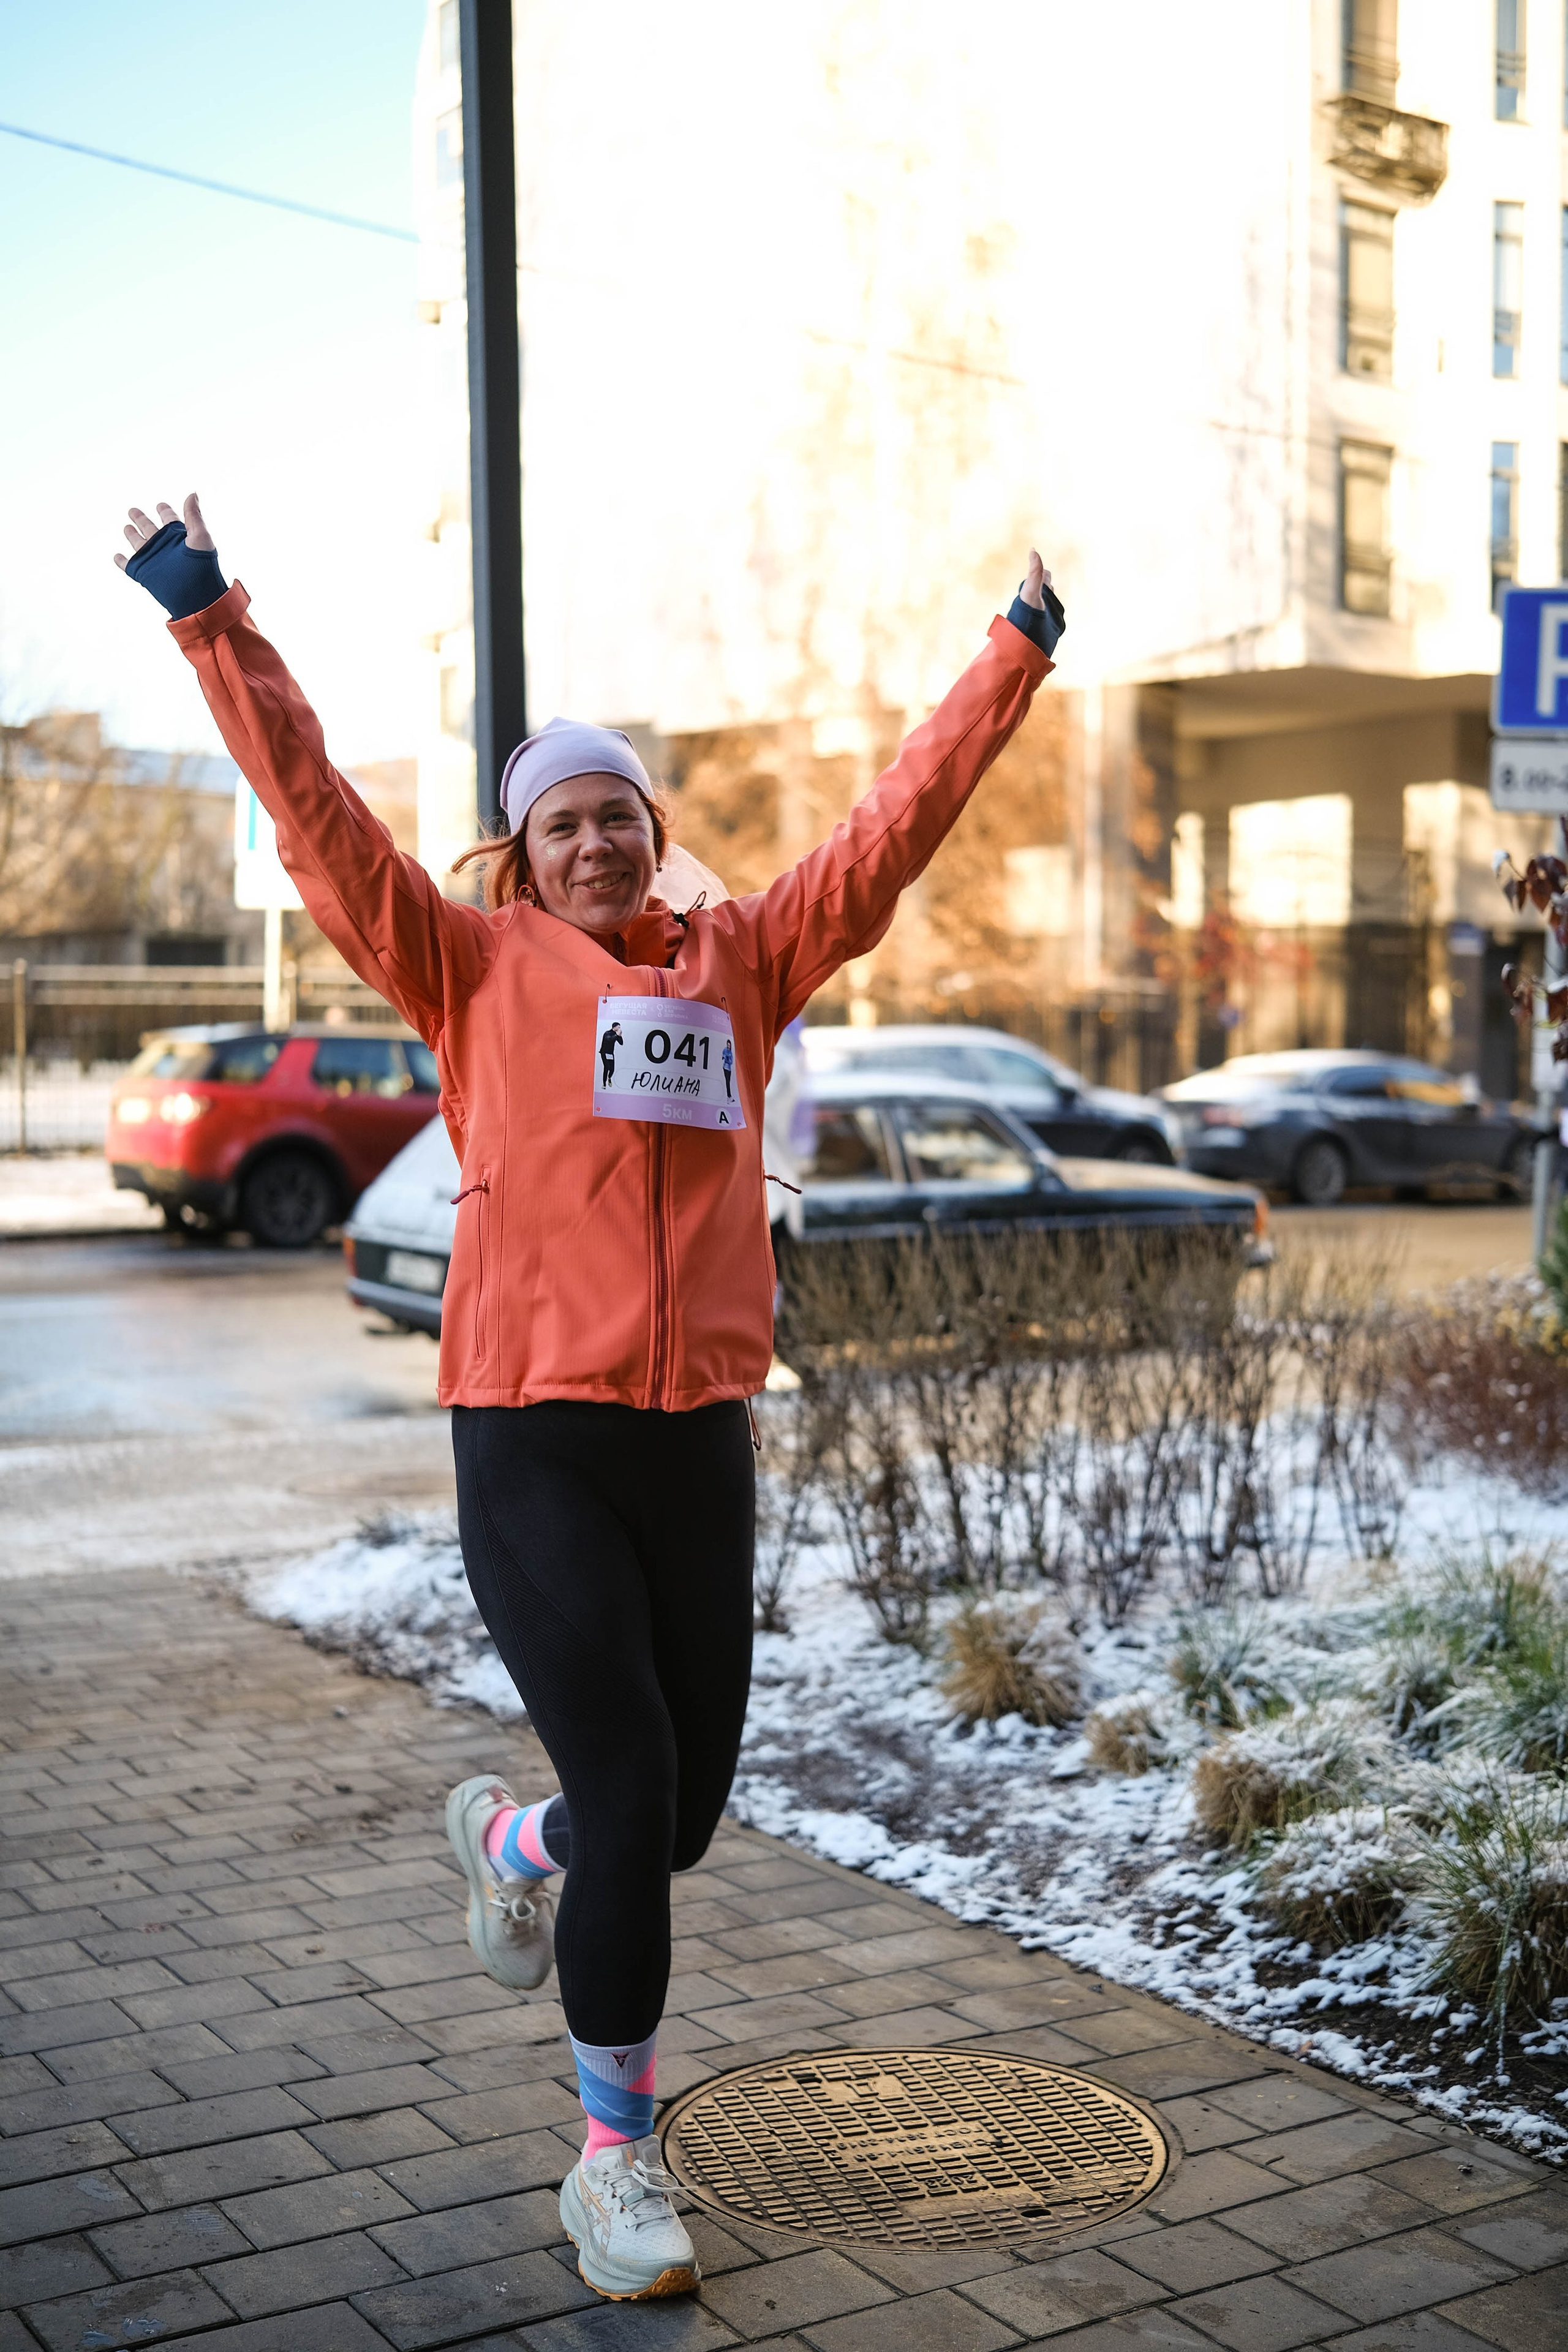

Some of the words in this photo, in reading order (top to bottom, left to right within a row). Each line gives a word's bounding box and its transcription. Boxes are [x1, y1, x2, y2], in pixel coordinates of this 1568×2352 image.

[644, 1030, 709, 1070] 041
[631, 1071, 700, 1096] ЮЛИАНА
[934, 2127, 982, 2138] ГОСТ
